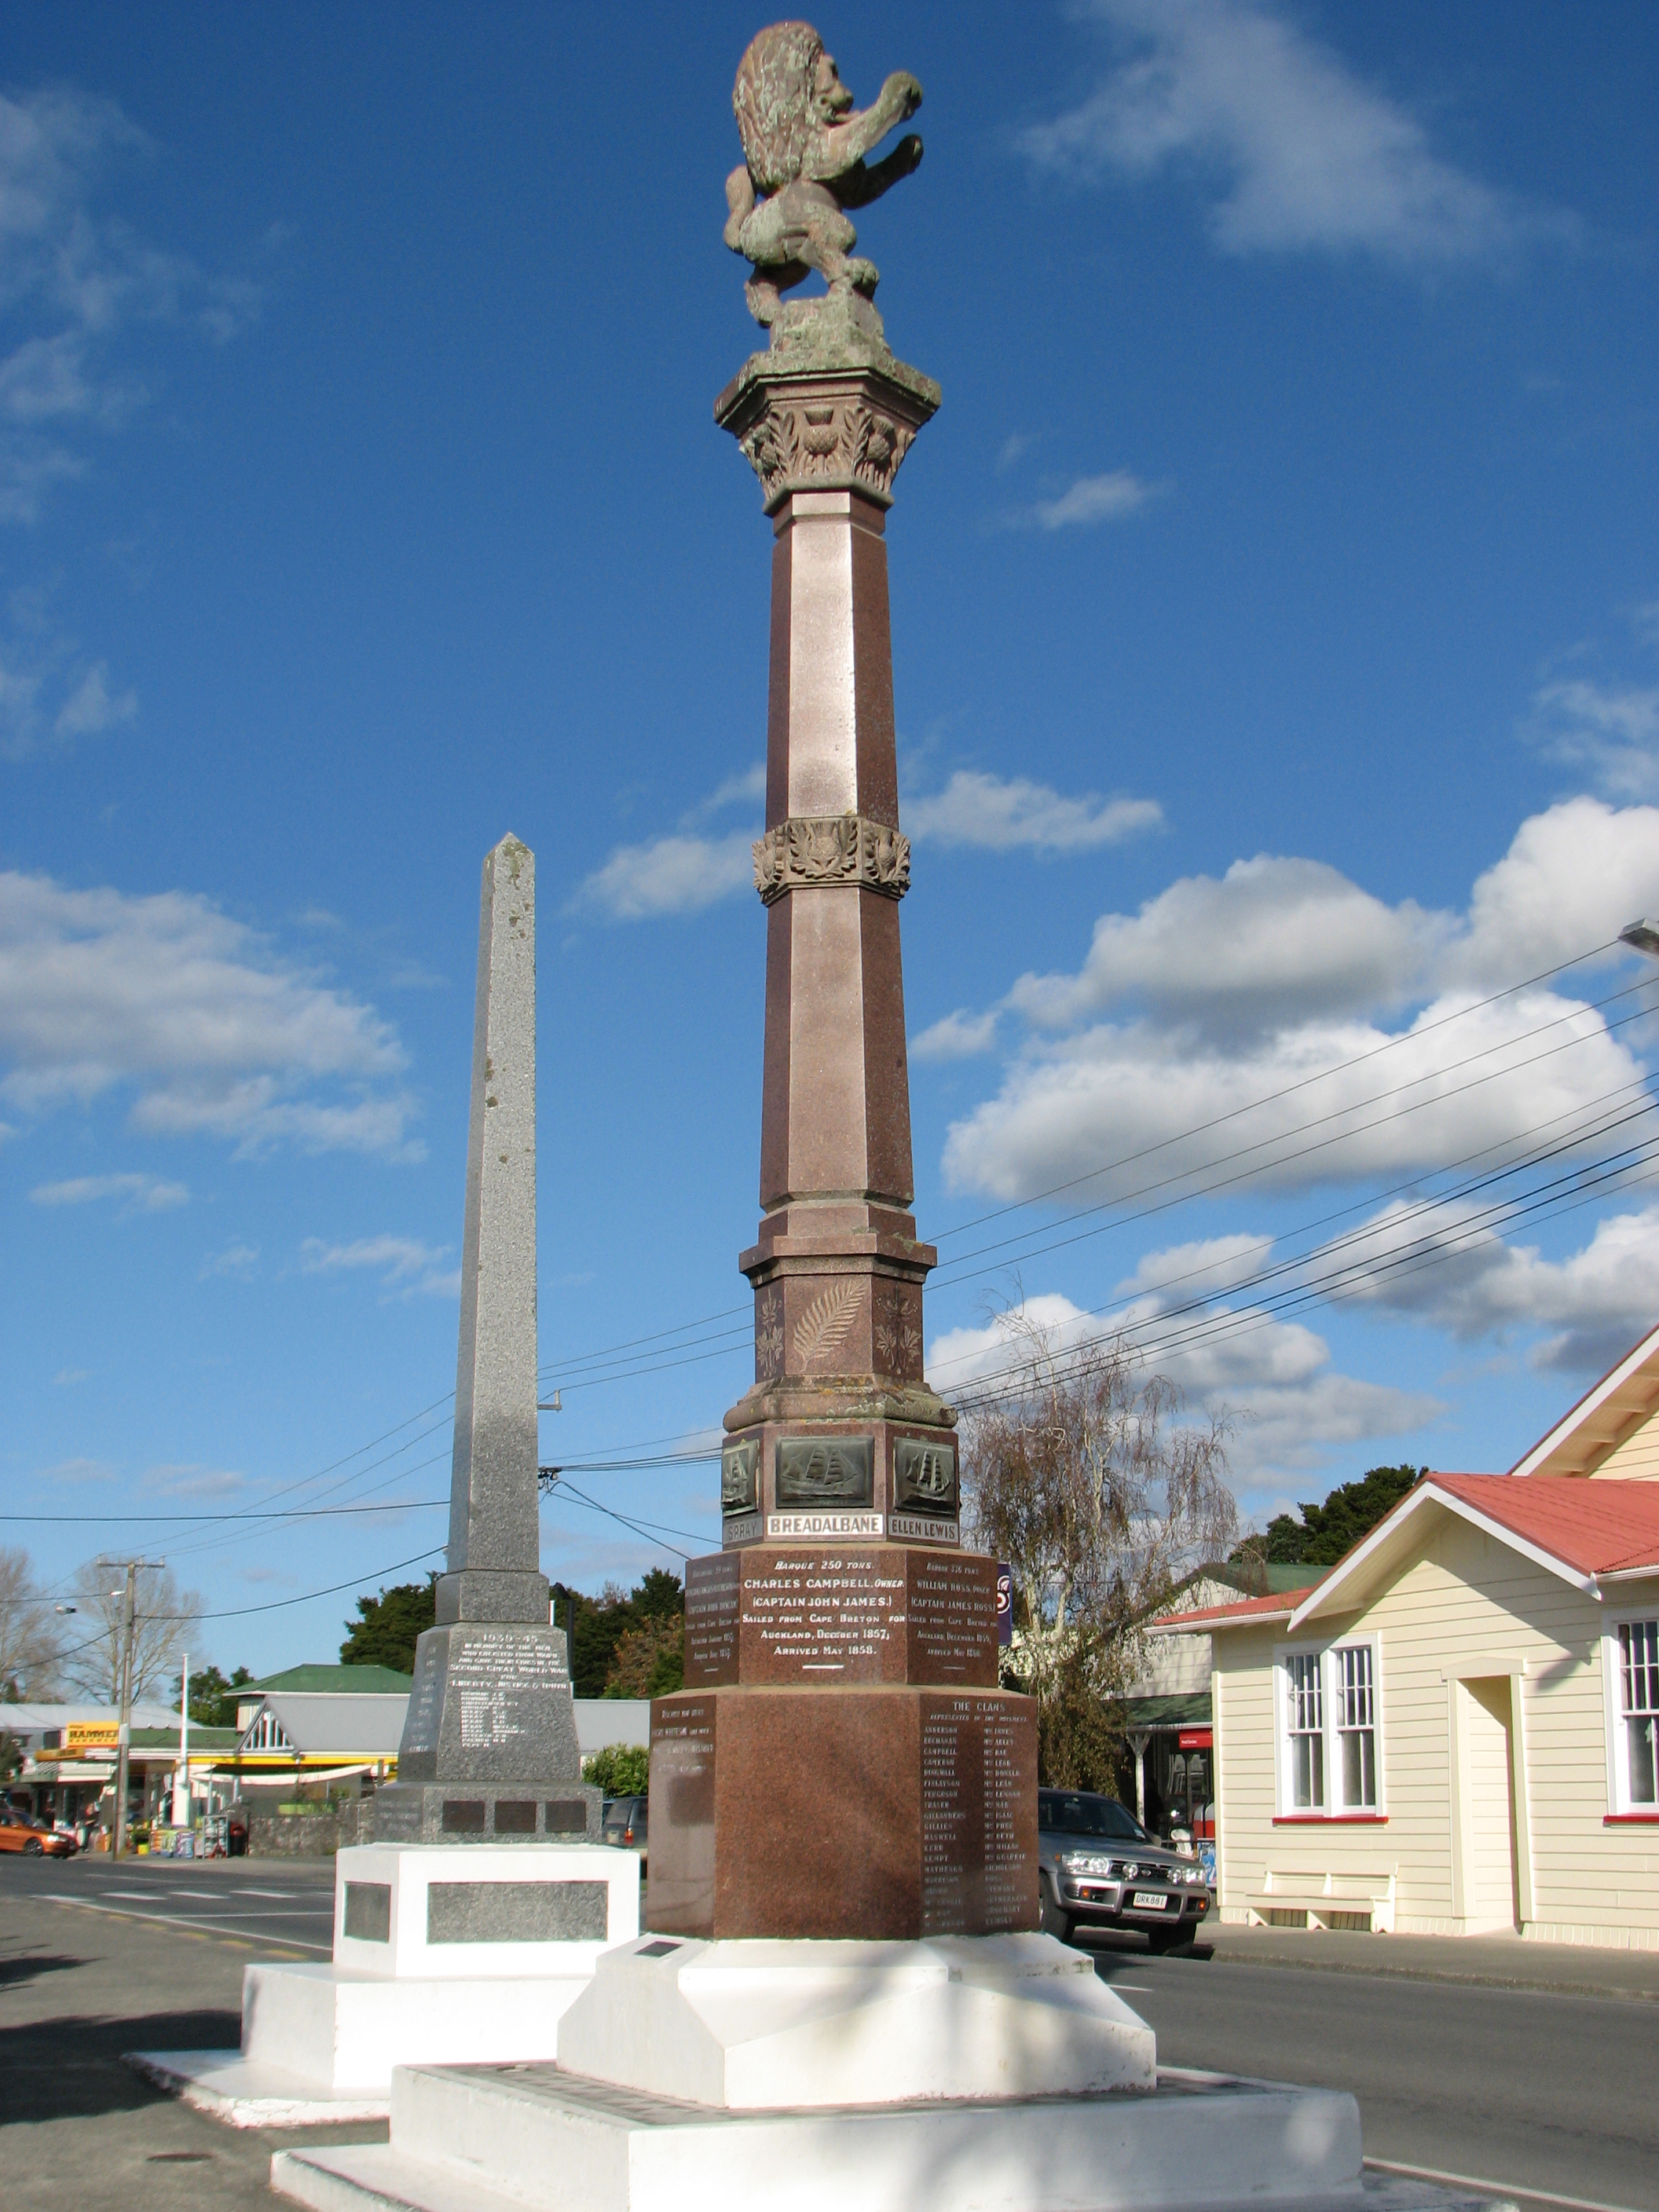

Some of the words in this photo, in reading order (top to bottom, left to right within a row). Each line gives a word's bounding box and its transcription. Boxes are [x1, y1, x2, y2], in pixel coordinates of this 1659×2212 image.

[771, 1517, 880, 1533] BREADALBANE
[892, 1518, 921, 1536] ELLEN
[925, 1523, 955, 1540] LEWIS
[728, 1522, 757, 1540] SPRAY
[775, 1561, 815, 1570] BARQUE
[821, 1560, 842, 1569] 250
[744, 1579, 800, 1589] CHARLES
[917, 1580, 947, 1591] WILLIAM
[807, 1597, 840, 1607] JOHN
[947, 1601, 972, 1610] JAMES
[742, 1613, 774, 1623] SAILED
[809, 1614, 833, 1623] CAPE
[840, 1614, 880, 1623] BRETON
[773, 1646, 819, 1655] ARRIVED
[823, 1646, 844, 1655] MAY
[848, 1646, 877, 1654] 1858.
[953, 1701, 970, 1711] THE
[976, 1701, 1005, 1712] CLANS
